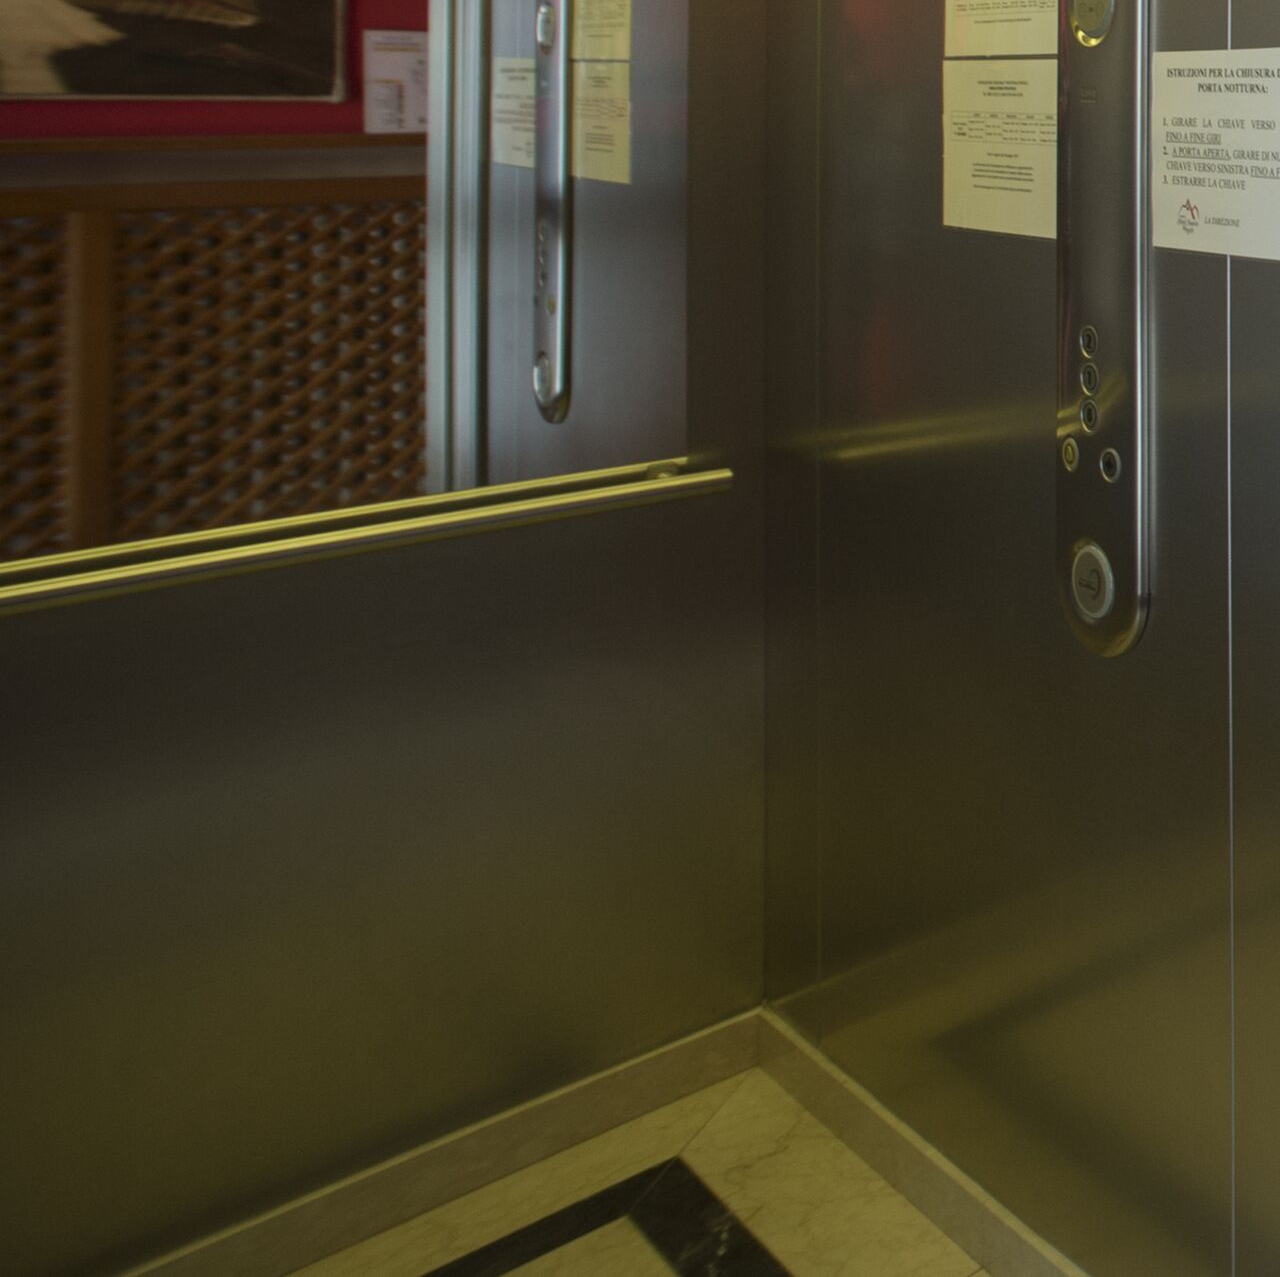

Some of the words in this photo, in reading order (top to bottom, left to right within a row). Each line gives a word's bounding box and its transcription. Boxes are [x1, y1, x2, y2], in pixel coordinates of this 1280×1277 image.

[1167, 68, 1207, 78] ISTRUZIONI
[1208, 68, 1223, 78] PER
[1224, 68, 1235, 78] LA
[1236, 68, 1275, 78] CHIUSURA
[1198, 83, 1223, 93] PORTA
[1224, 83, 1268, 94] NOTTURNA:
[1171, 118, 1197, 127] GIRARE
[1203, 118, 1212, 128] LA
[1217, 119, 1245, 129] CHIAVE
[1251, 120, 1275, 131] VERSO
[1166, 132, 1183, 142] FINO
[1190, 133, 1206, 143] FINE
[1207, 134, 1221, 144] GIRI
[1178, 147, 1201, 158] PORTA
[1233, 150, 1260, 160] GIRARE
[1261, 151, 1269, 161] DI
[1166, 161, 1192, 171] CHIAVE
[1193, 162, 1216, 172] VERSO
[1217, 164, 1248, 175] SINISTRA
[1250, 166, 1268, 178] FINO
[1172, 176, 1206, 187] ESTRARRE
[1208, 179, 1217, 188] LA
[1219, 180, 1246, 190] CHIAVE
